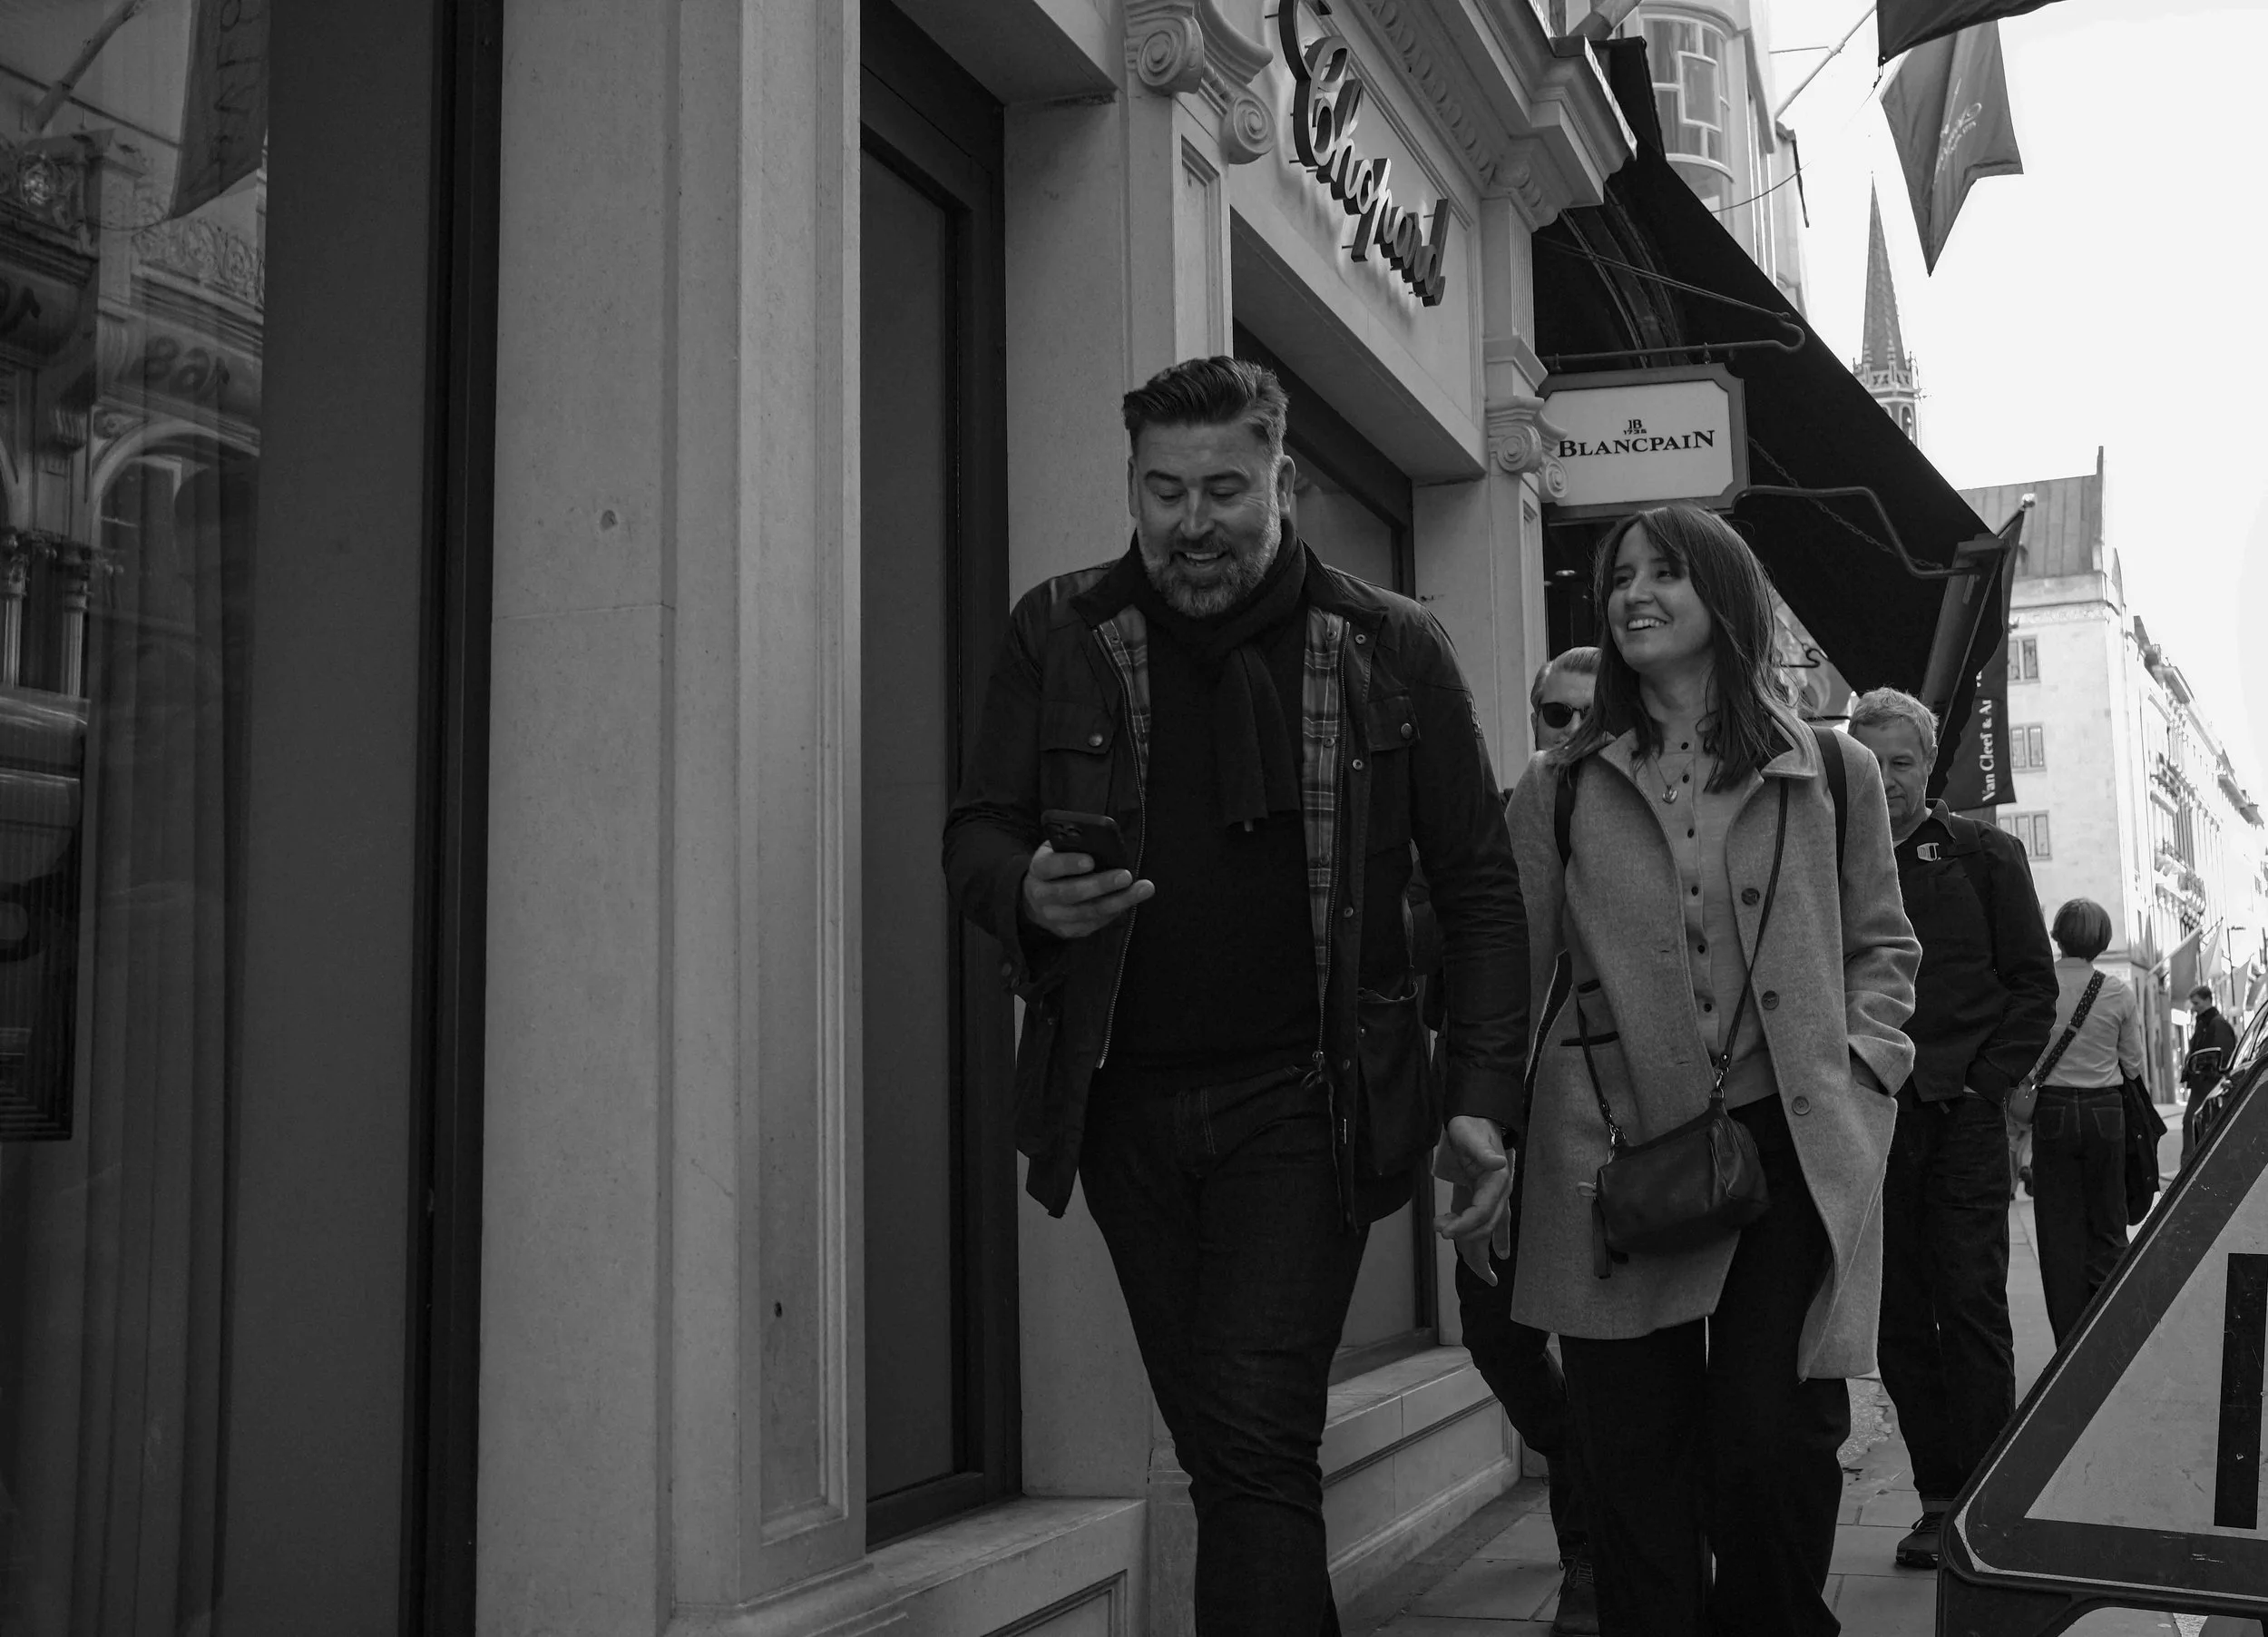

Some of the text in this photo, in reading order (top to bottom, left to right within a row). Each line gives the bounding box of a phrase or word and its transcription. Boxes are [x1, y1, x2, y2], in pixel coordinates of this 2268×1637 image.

[1278, 0, 1451, 307] Chopard
[1558, 430, 1716, 457] BLANCPAIN
[1980, 732, 1995, 771] Cleef
[1982, 773, 1996, 802] Van
